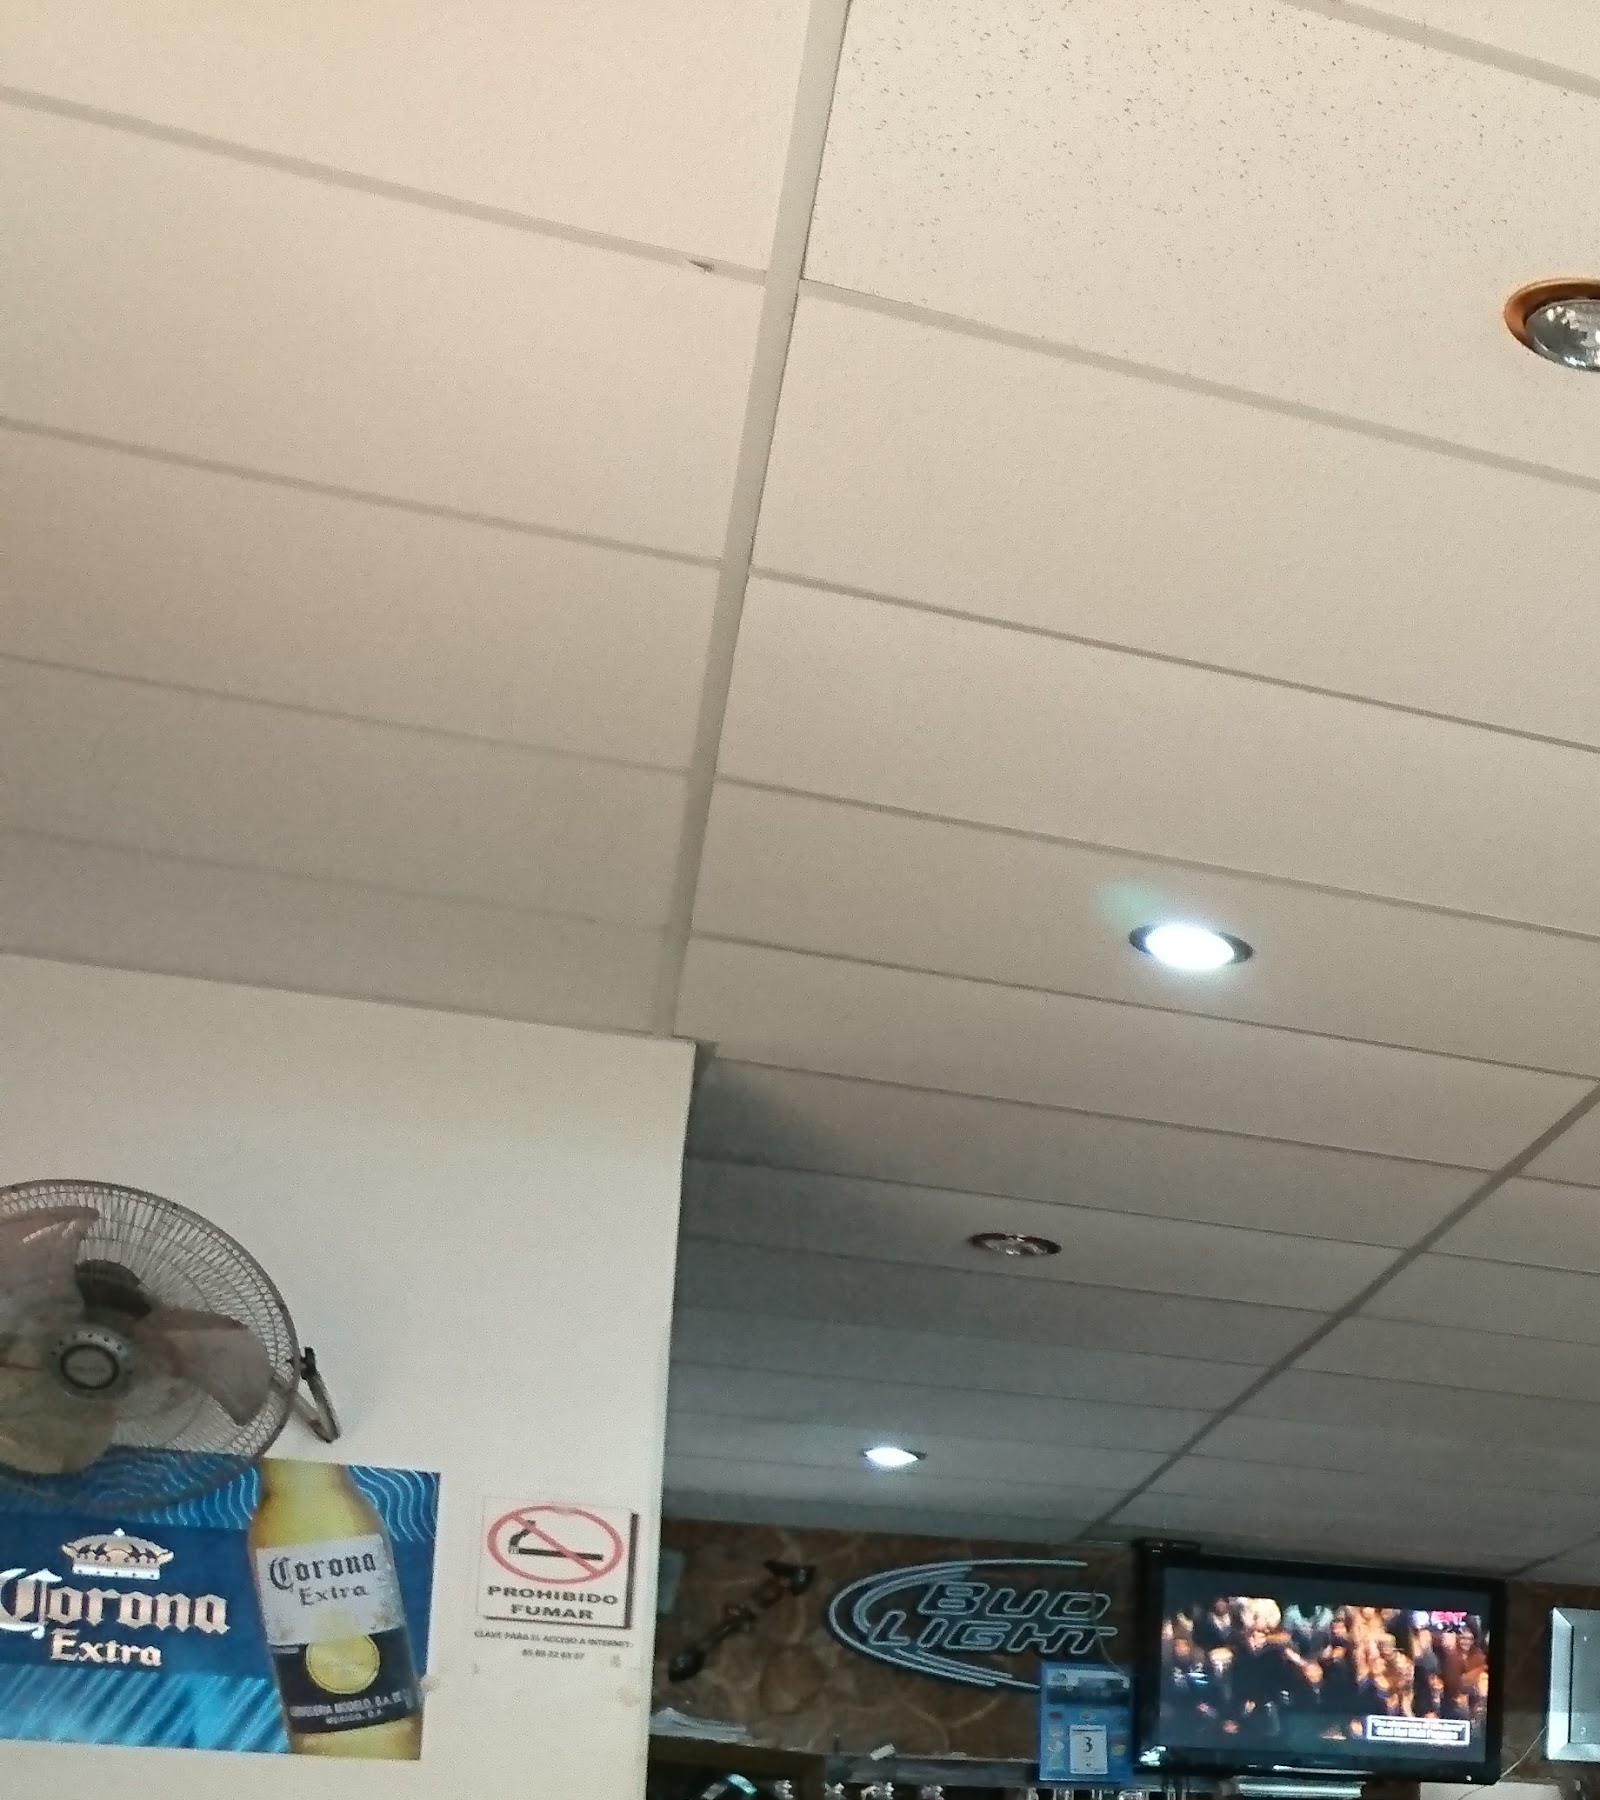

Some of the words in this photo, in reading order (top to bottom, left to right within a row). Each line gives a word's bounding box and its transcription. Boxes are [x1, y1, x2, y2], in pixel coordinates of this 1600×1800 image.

[269, 1553, 376, 1592] Corona
[0, 1568, 230, 1639] Corona
[300, 1585, 369, 1606] Extra
[488, 1585, 619, 1605] PROHIBIDO
[511, 1603, 594, 1619] FUMAR
[918, 1581, 1111, 1621] BUD
[51, 1628, 162, 1667] Extra
[868, 1610, 1118, 1654] LIGHT
[1083, 1736, 1094, 1754] 3
